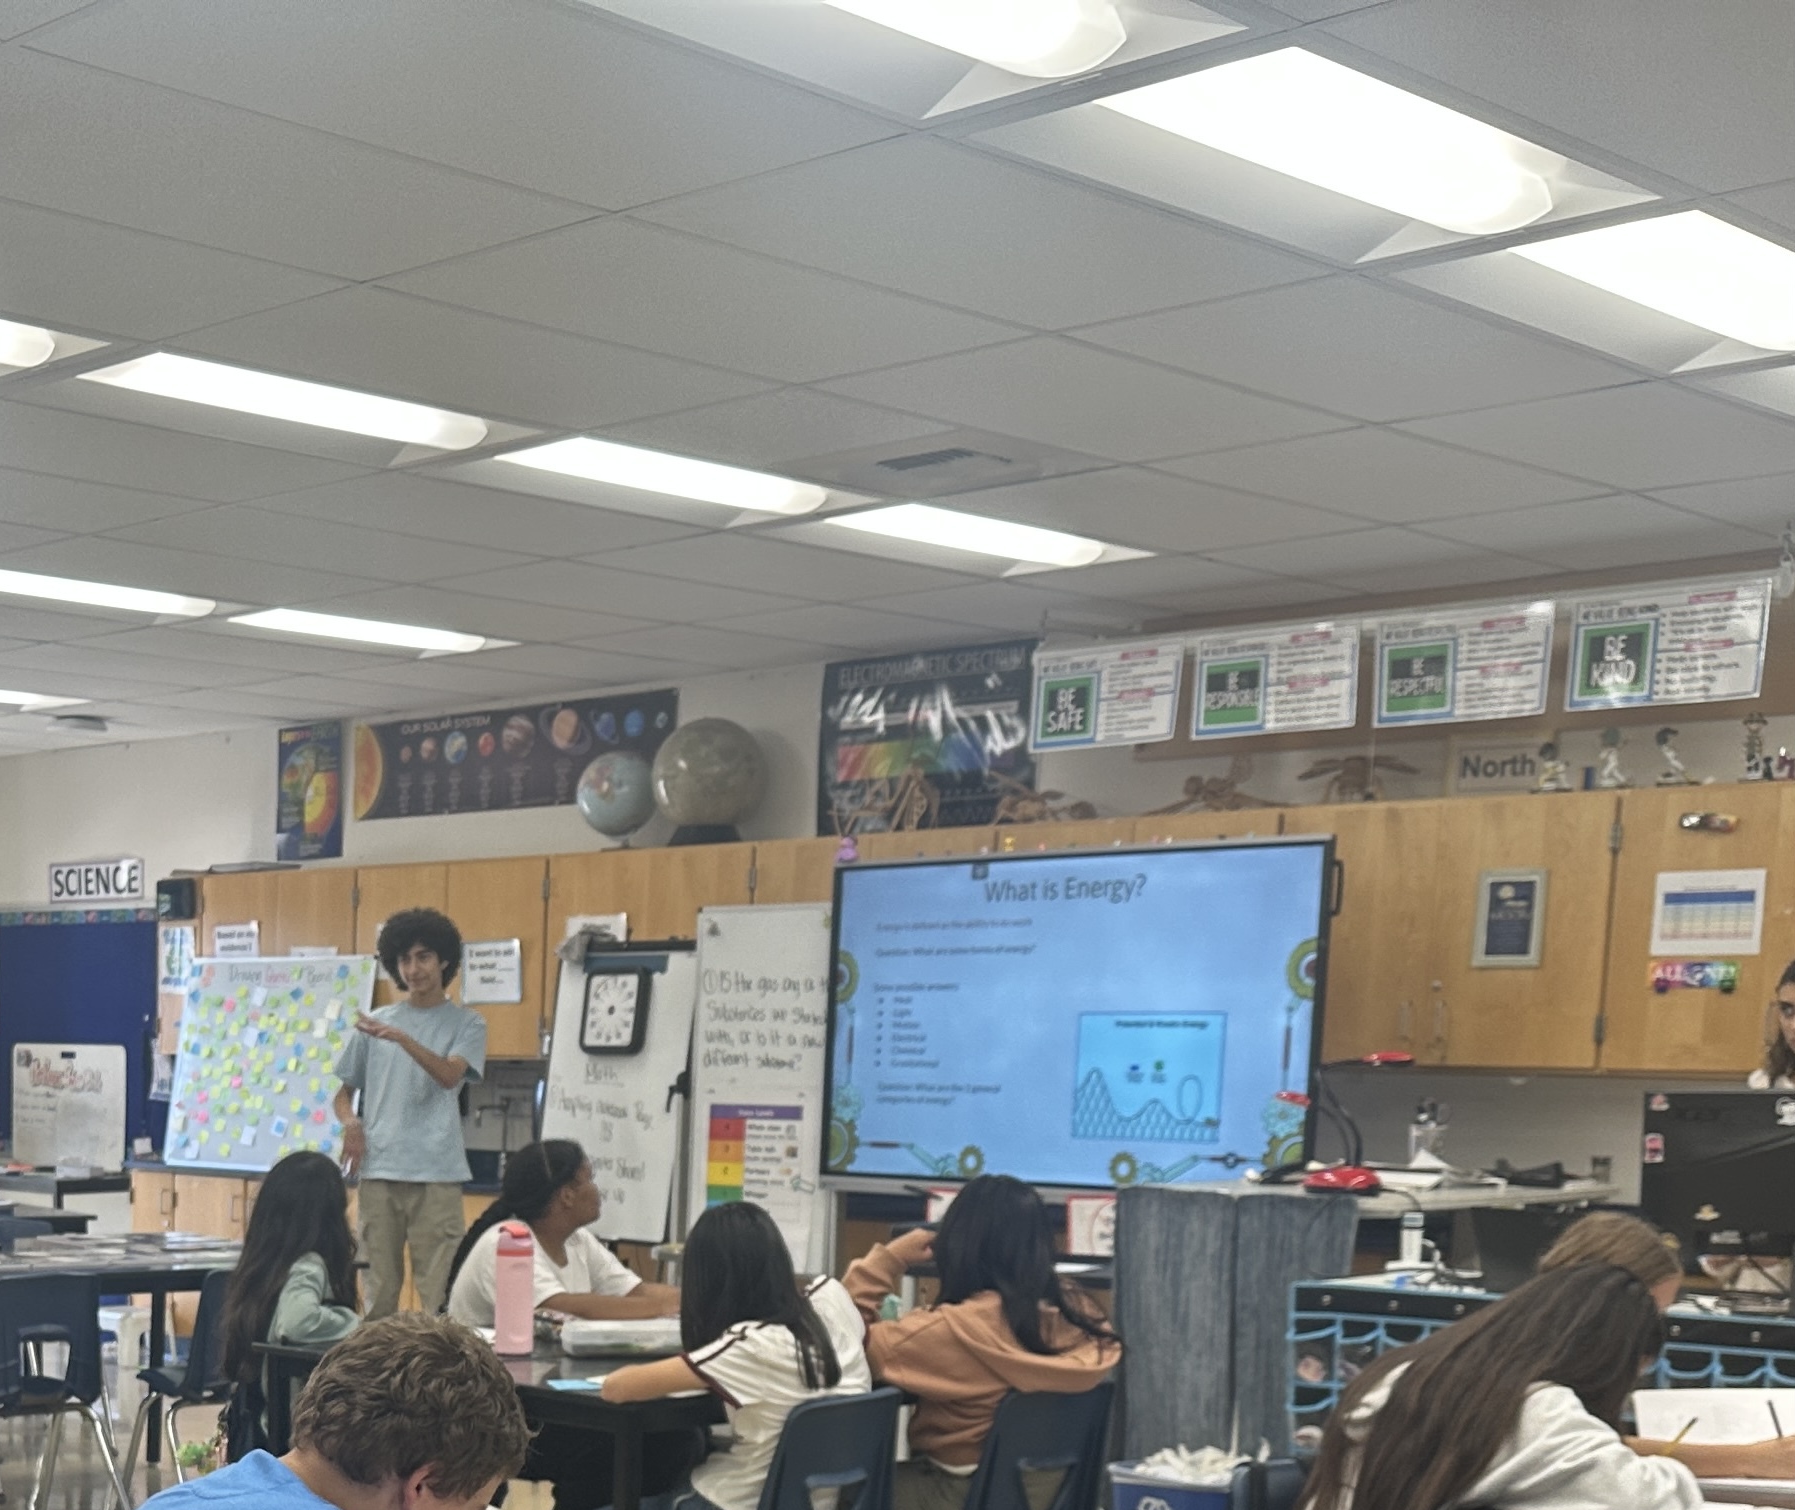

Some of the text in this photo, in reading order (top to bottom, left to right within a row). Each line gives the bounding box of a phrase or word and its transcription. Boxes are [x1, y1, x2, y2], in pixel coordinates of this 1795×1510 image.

[1604, 634, 1628, 660] BE
[1412, 657, 1425, 675] BE
[1590, 659, 1637, 689] KIND
[1228, 671, 1240, 691] BE
[1057, 688, 1076, 709] BE
[402, 716, 491, 735] OUR SOLAR SYSTEM
[1047, 707, 1085, 734] SAFE
[1461, 753, 1536, 779] North
[54, 865, 139, 897] SCIENCE
[985, 872, 1147, 904] What is Energy?
[757, 976, 778, 998] gas
